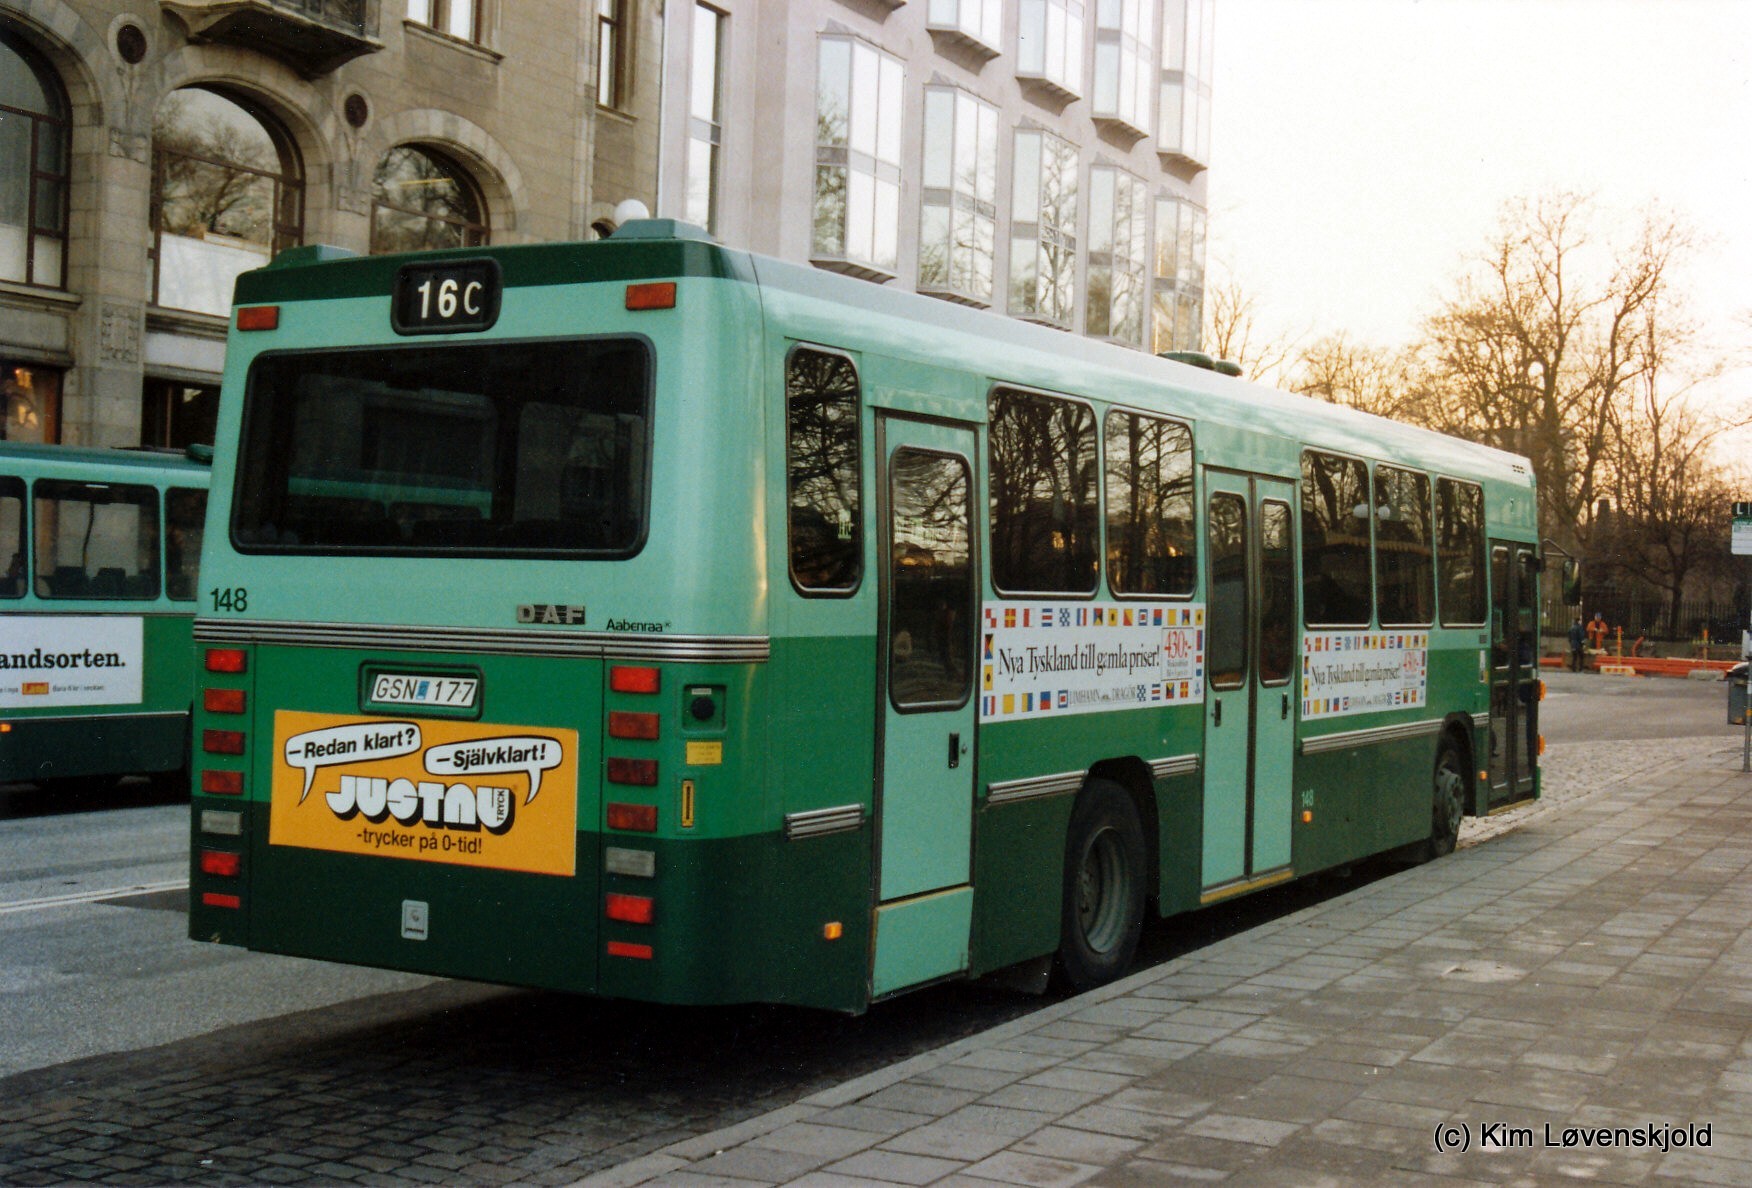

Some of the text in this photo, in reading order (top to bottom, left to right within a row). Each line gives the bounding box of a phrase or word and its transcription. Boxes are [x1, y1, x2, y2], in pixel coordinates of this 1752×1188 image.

[417, 278, 483, 319] 16C
[210, 587, 248, 612] 148
[516, 604, 585, 625] DAF
[606, 618, 664, 633] Aabenraa
[0, 648, 126, 669] andsorten.
[998, 648, 1024, 682] Nya
[1026, 643, 1079, 681] Tyskland
[1080, 643, 1096, 670] till
[1129, 643, 1160, 675] priser!
[376, 678, 475, 703] GSN 177
[363, 728, 416, 751] klart?
[496, 790, 505, 822] TRYCK
[357, 828, 415, 848] -trycker
[419, 832, 438, 852] på
